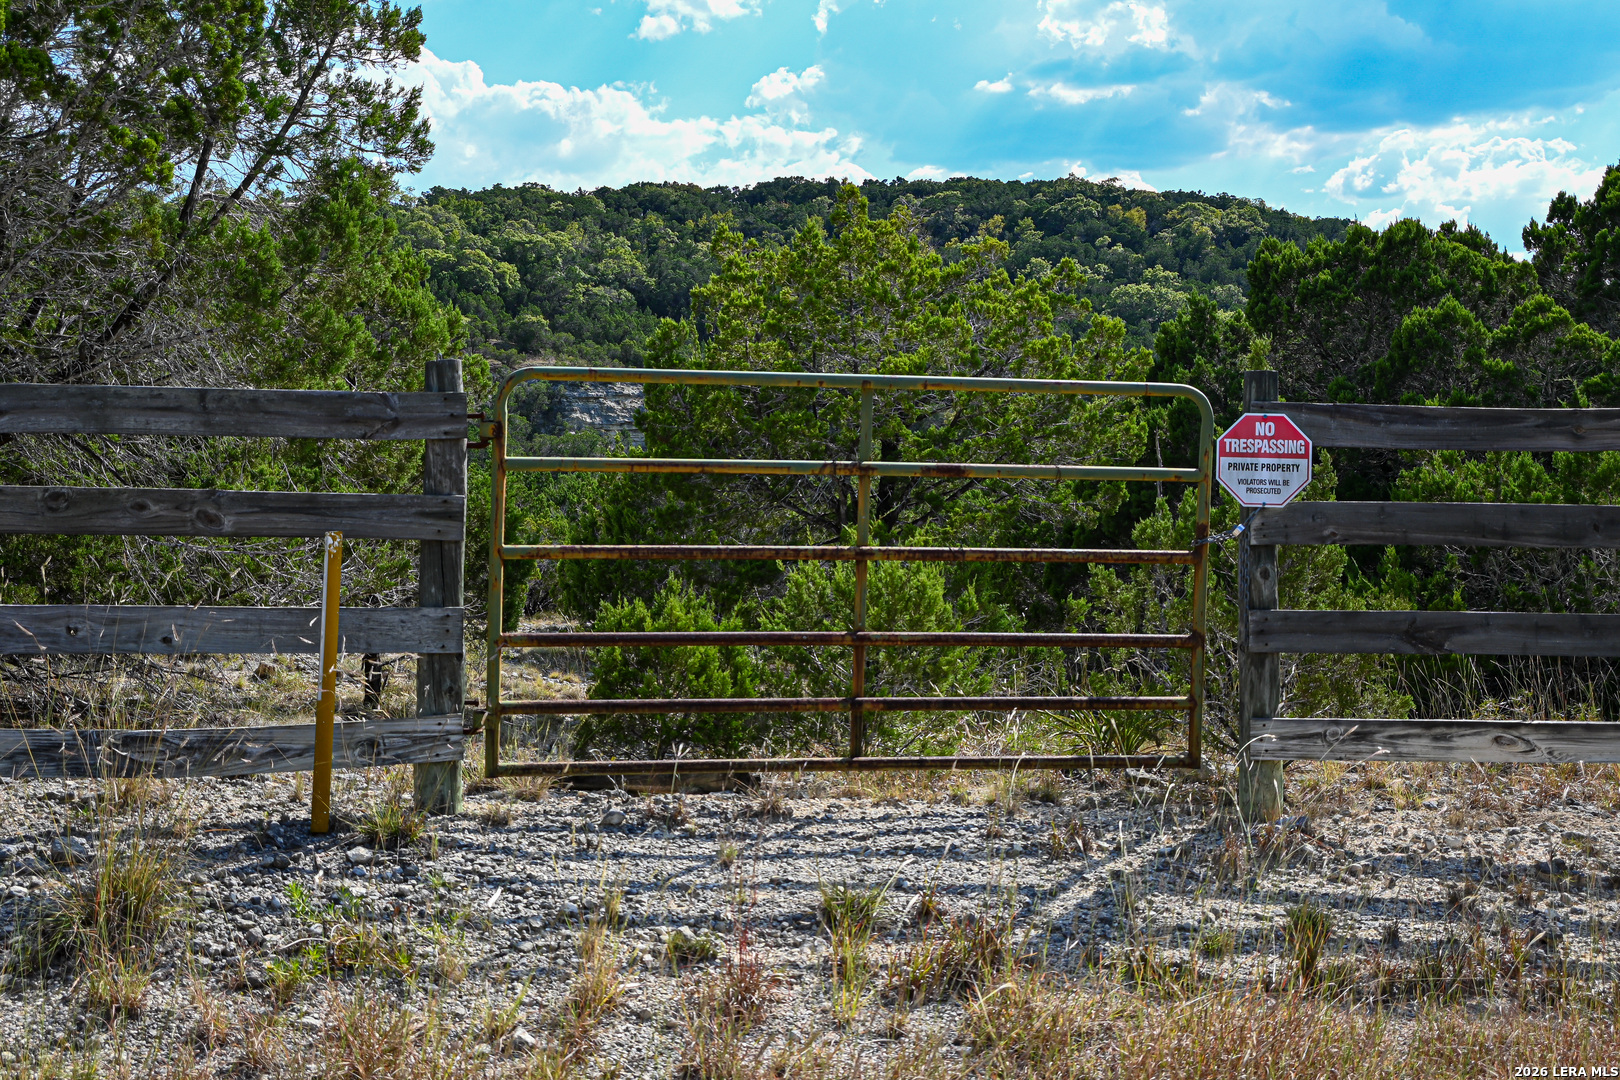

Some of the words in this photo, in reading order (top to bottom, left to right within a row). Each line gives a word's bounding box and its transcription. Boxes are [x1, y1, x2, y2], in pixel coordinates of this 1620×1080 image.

[1255, 422, 1275, 436] NO
[1224, 438, 1305, 454] TRESPASSING
[1228, 462, 1258, 471] PRIVATE
[1261, 463, 1300, 472] PROPERTY
